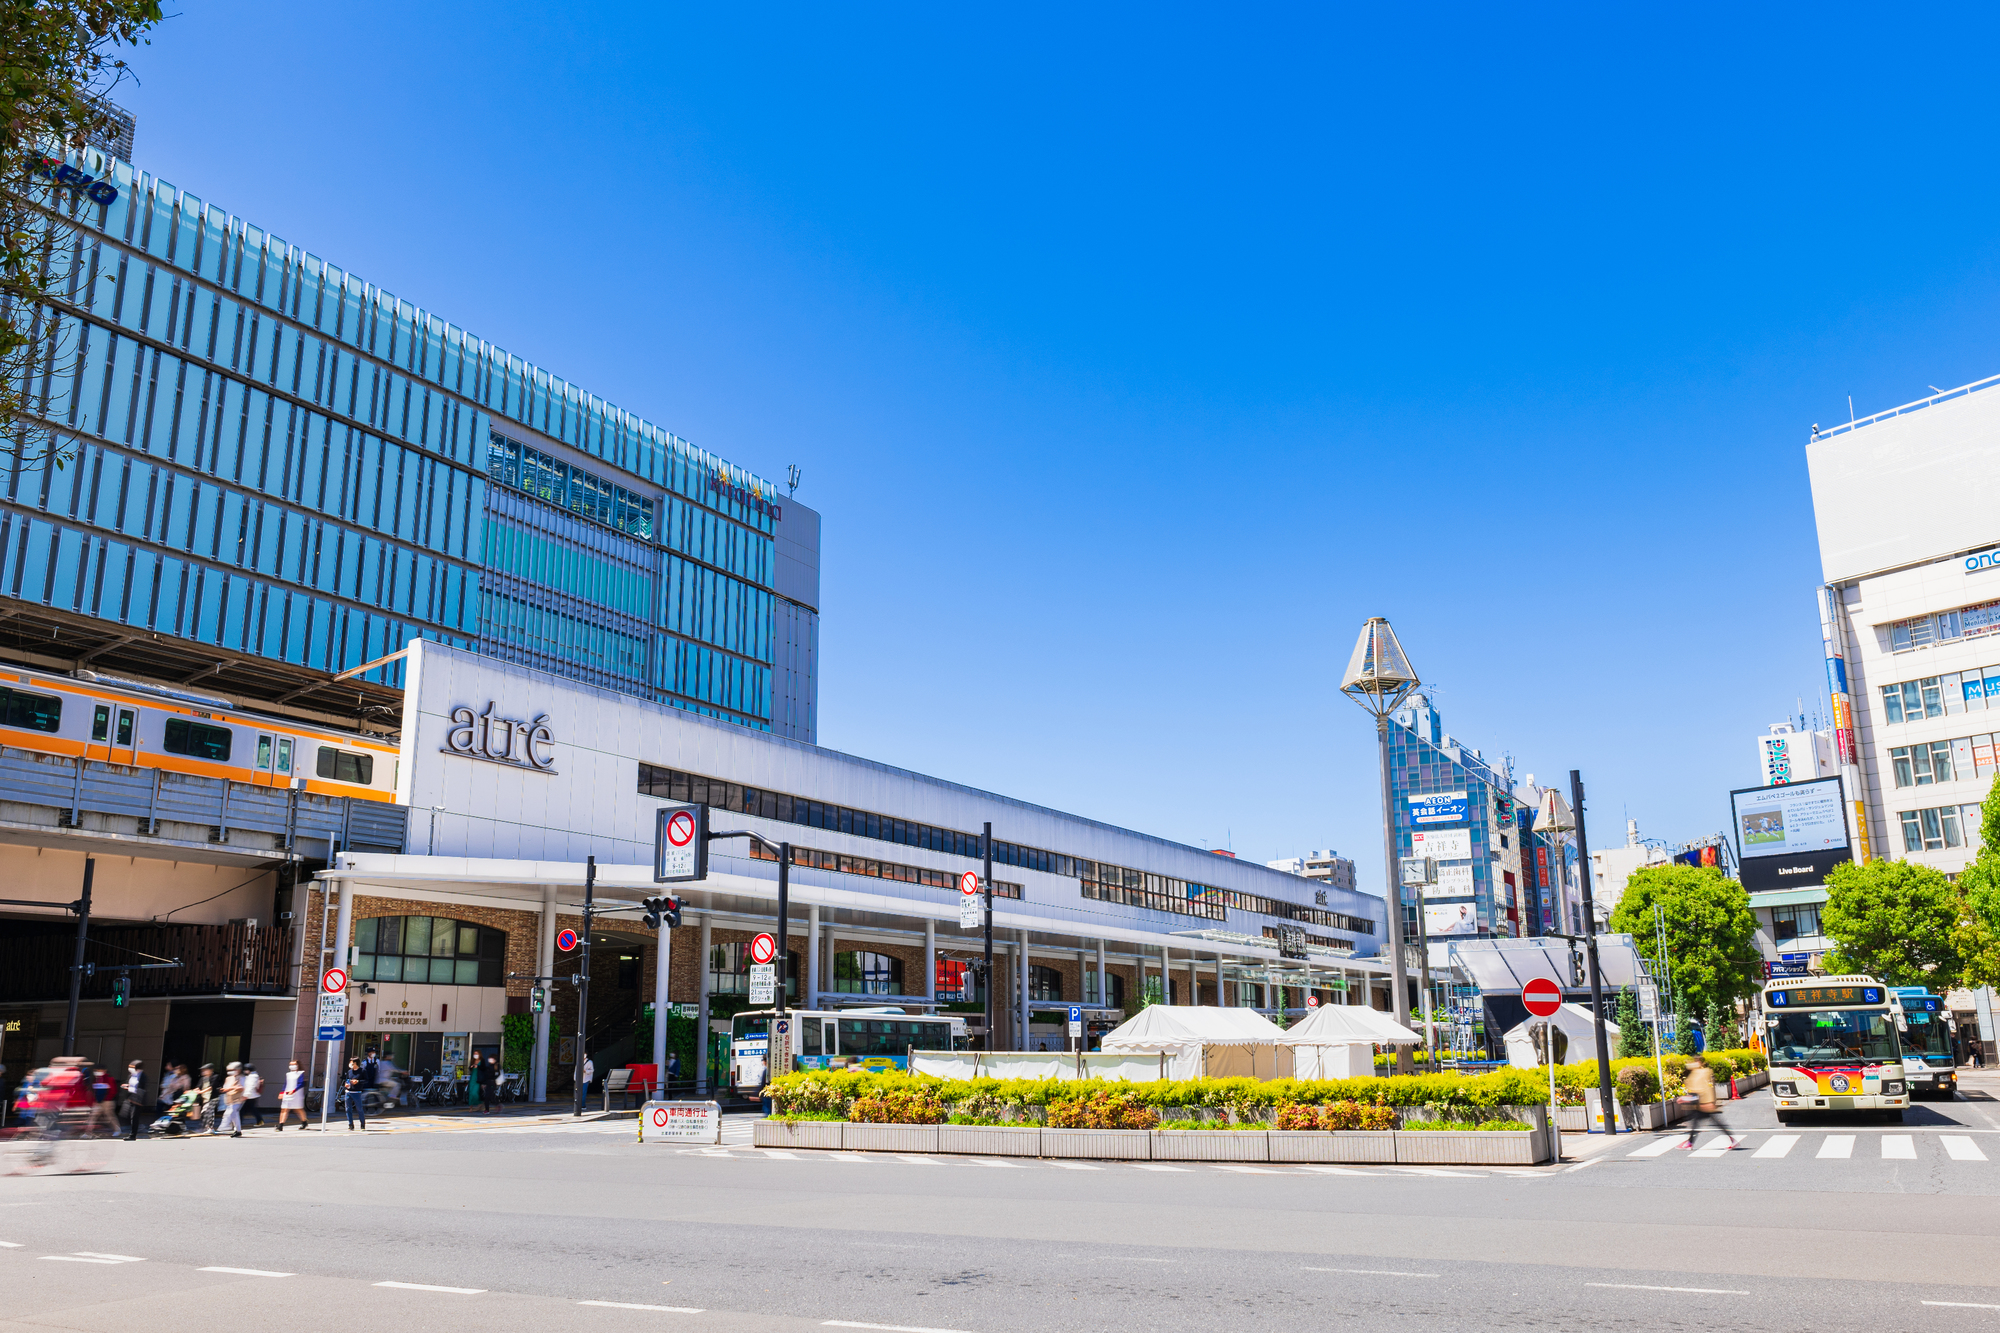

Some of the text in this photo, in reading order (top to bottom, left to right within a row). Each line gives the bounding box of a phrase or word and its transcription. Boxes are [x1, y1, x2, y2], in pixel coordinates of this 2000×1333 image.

[711, 468, 781, 522] kirarina
[448, 700, 555, 769] atré
[1425, 796, 1452, 806] AEON
[1412, 805, 1466, 817] 英会話イーオン
[1793, 865, 1814, 874] Board
[1795, 988, 1854, 1001] 吉祥寺駅
[671, 1005, 680, 1013] JR
[1072, 1008, 1079, 1020] P
[669, 1107, 708, 1117] 車両通行止
